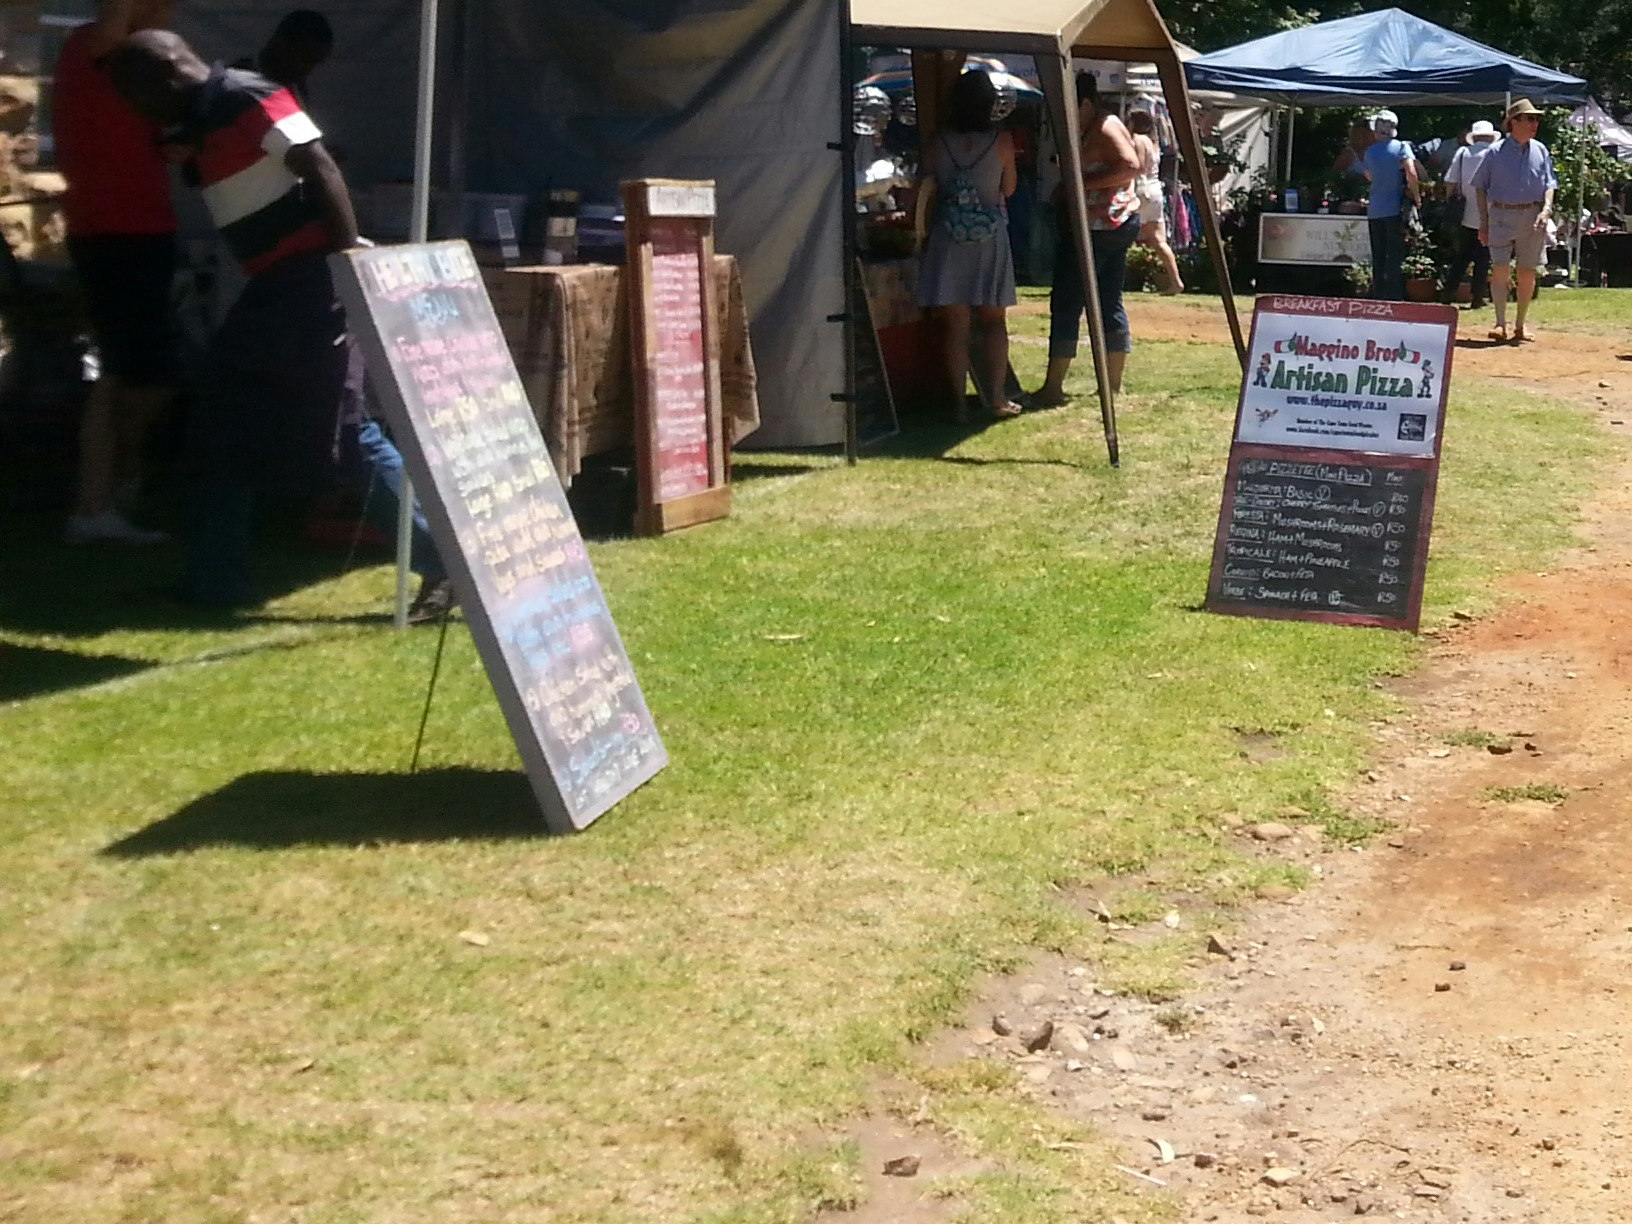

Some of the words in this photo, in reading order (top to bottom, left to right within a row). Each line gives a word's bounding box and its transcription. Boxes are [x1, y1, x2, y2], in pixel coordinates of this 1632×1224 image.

[1273, 297, 1342, 313] BREAKFAST
[1348, 302, 1394, 316] PIZZA
[1271, 360, 1349, 394] Artisan
[1355, 365, 1414, 398] Pizza
